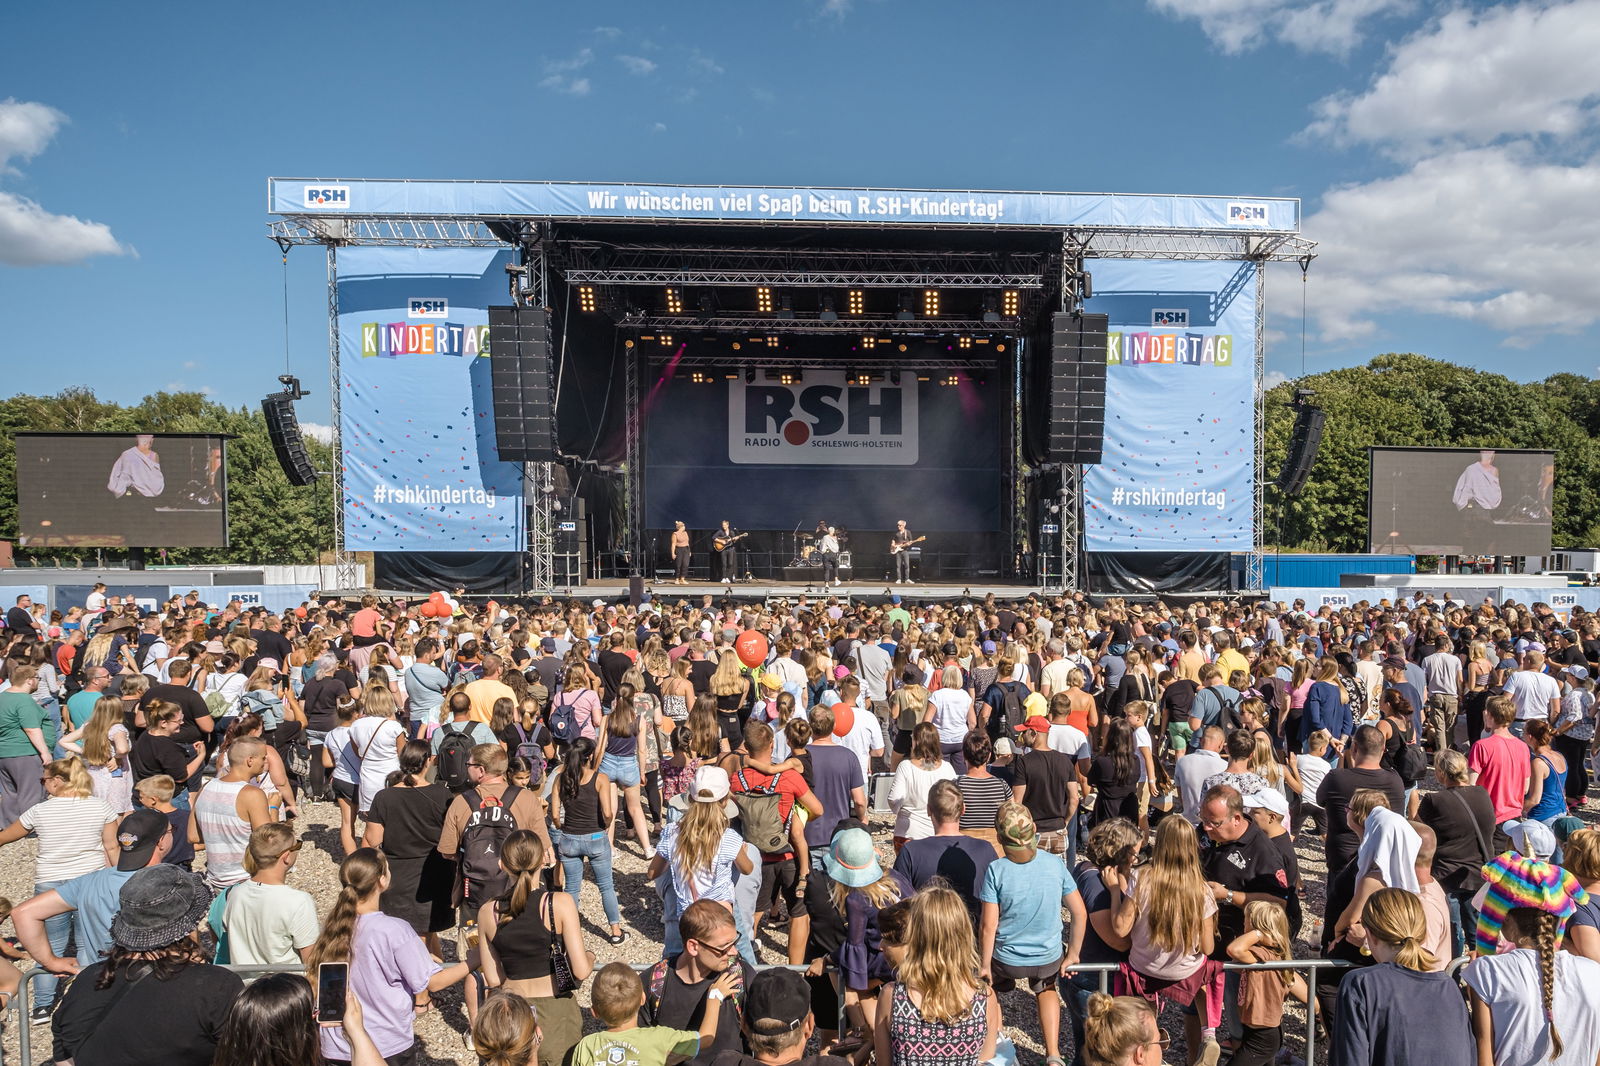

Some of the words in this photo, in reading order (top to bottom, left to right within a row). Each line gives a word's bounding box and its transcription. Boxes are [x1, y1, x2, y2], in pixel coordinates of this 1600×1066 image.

[587, 191, 618, 209] Wir
[624, 191, 714, 211] wünschen
[720, 193, 752, 212] viel
[758, 194, 803, 216] Spaß
[809, 195, 852, 214] beim
[858, 196, 1004, 220] R.SH-Kindertag!
[1107, 336, 1229, 362] KINDERTAG
[744, 437, 781, 447] RADIO
[811, 440, 903, 448] SCHLESWIG-HOLSTEIN
[373, 484, 496, 509] #rshkindertag
[1111, 487, 1226, 511] #rshkindertag
